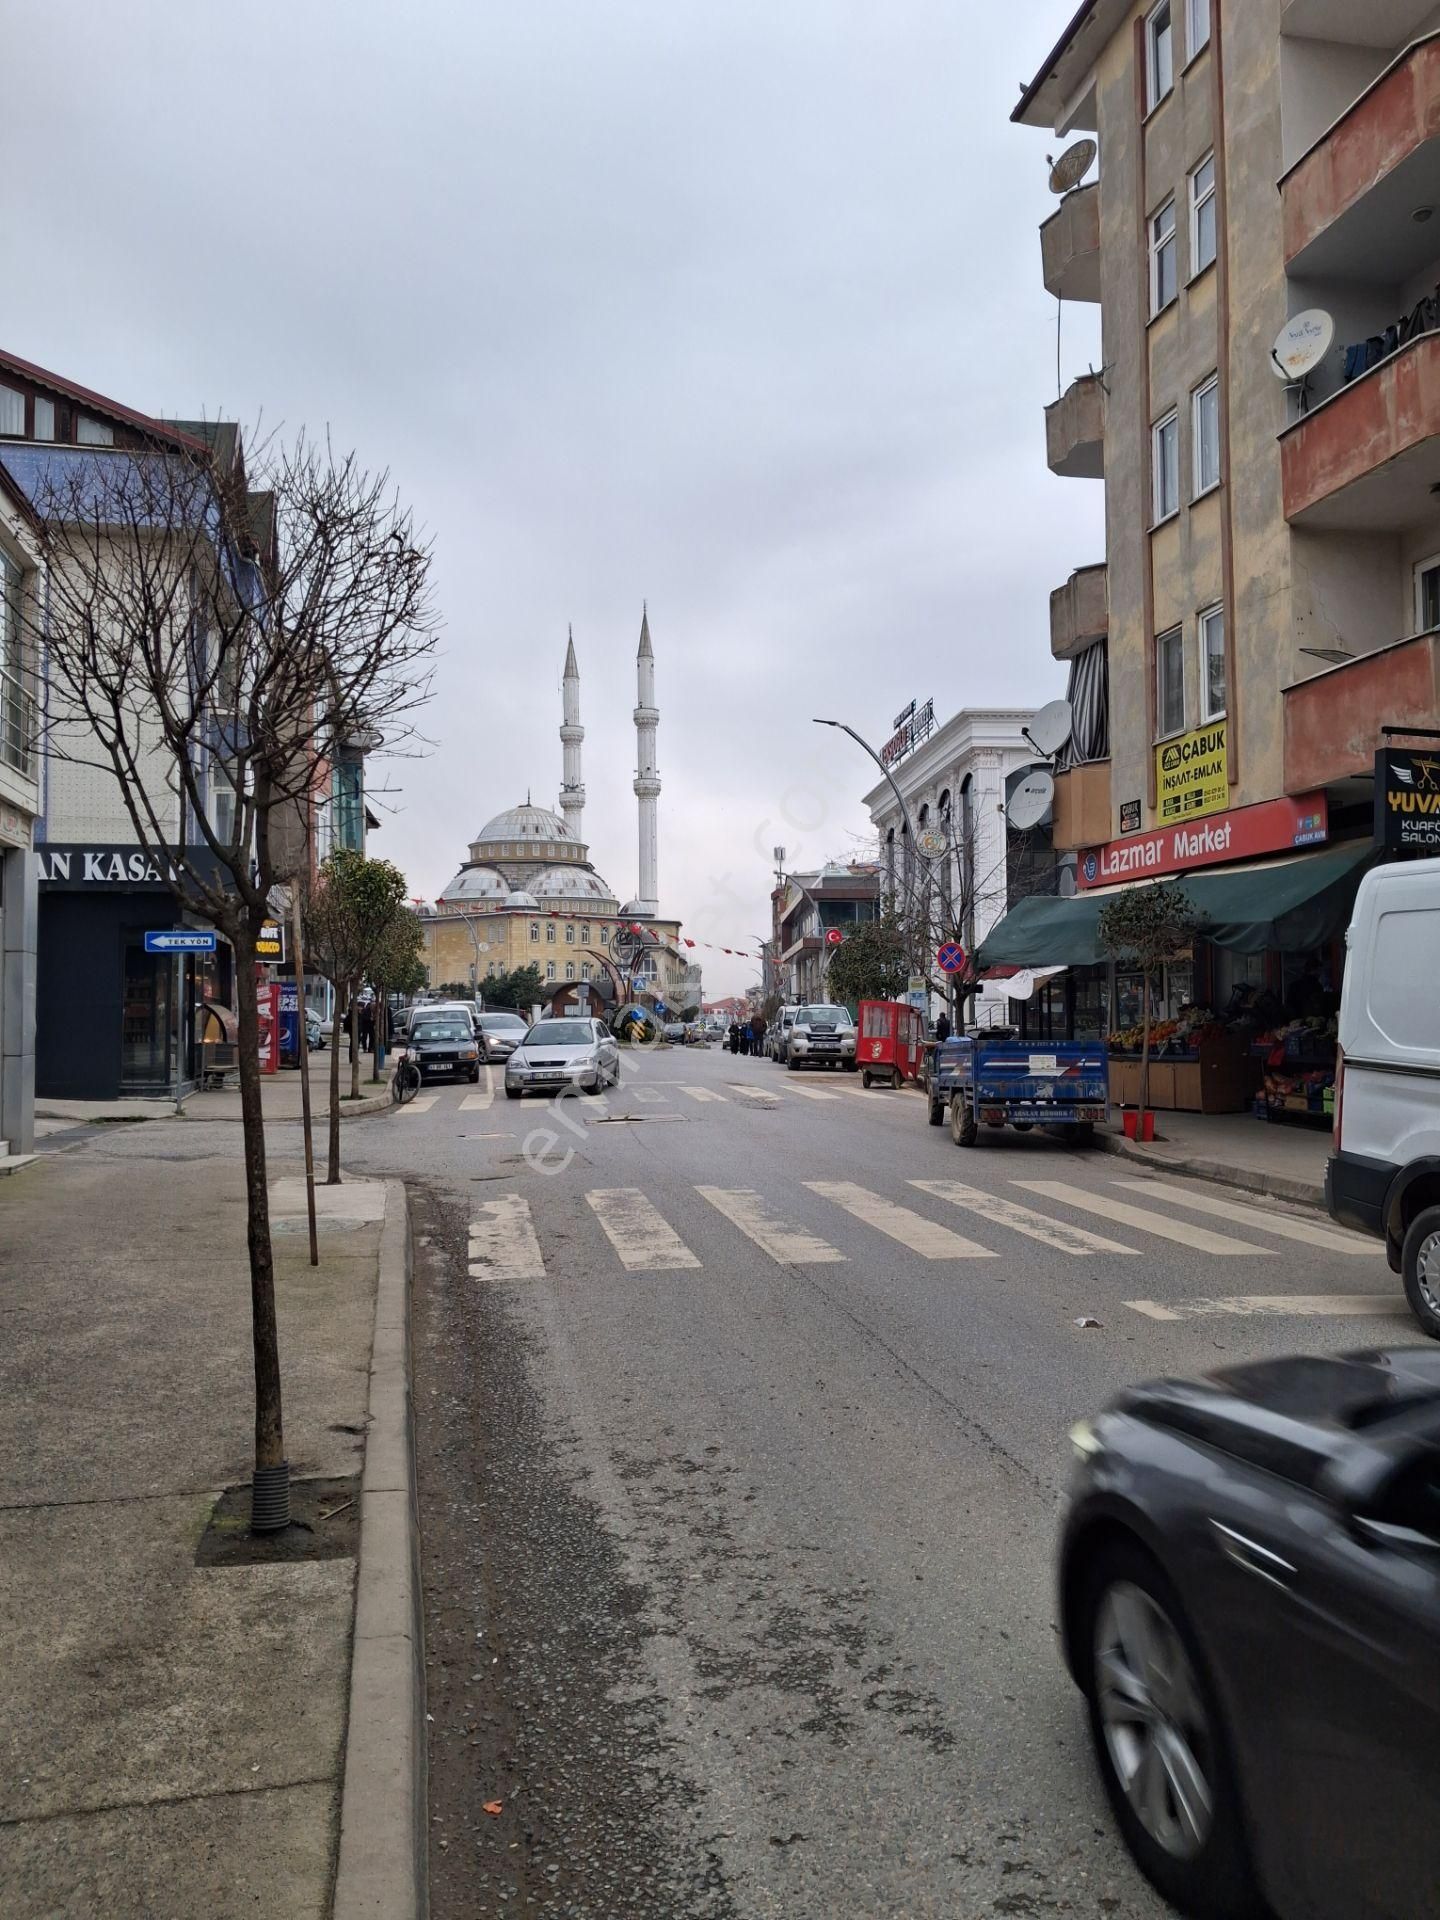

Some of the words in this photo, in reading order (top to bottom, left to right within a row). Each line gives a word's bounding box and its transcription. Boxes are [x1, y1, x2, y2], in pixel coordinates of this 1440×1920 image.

[1182, 730, 1225, 764] ÇABUK
[1162, 759, 1222, 791] İNŞAAT-EMLAK
[1100, 837, 1164, 876] Lazmar
[1173, 820, 1232, 860] Market
